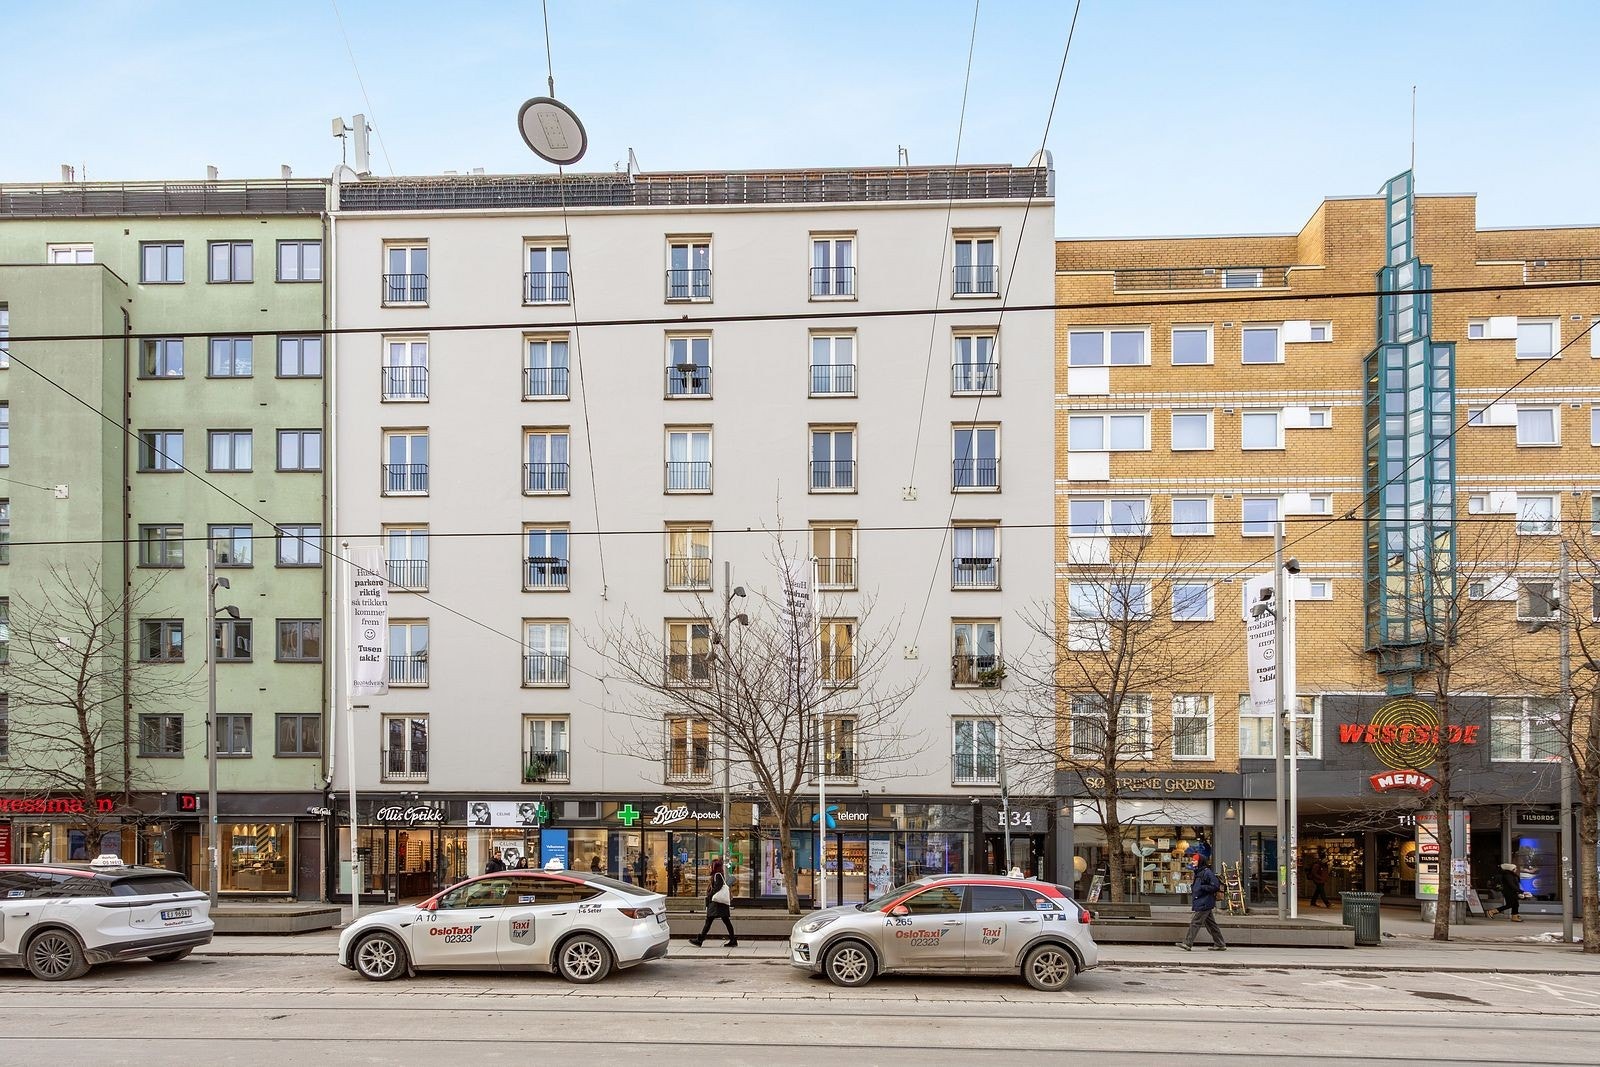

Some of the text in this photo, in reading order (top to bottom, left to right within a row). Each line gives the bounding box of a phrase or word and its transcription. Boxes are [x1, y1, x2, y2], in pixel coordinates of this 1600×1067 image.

[354, 579, 384, 587] parkere
[359, 589, 380, 597] riktig
[354, 608, 385, 616] kommer
[361, 618, 380, 626] frem
[357, 645, 382, 653] Tusen
[1339, 723, 1480, 744] WESTSIDE
[1085, 777, 1216, 792] SØTRENE GRENE
[1377, 774, 1431, 789] MENY
[182, 795, 195, 809] D
[376, 806, 444, 826] Ollis Optikk
[650, 805, 721, 825] Boots Apotek
[837, 811, 869, 821] telenor
[416, 914, 437, 922] A 10
[885, 918, 913, 927] A 265
[512, 920, 530, 930] Taxi
[429, 926, 473, 936] OsloTaxi
[895, 929, 940, 939] OsloTaxi
[983, 927, 1002, 937] Taxi
[445, 935, 473, 944] 02323
[911, 938, 940, 947] 02323
